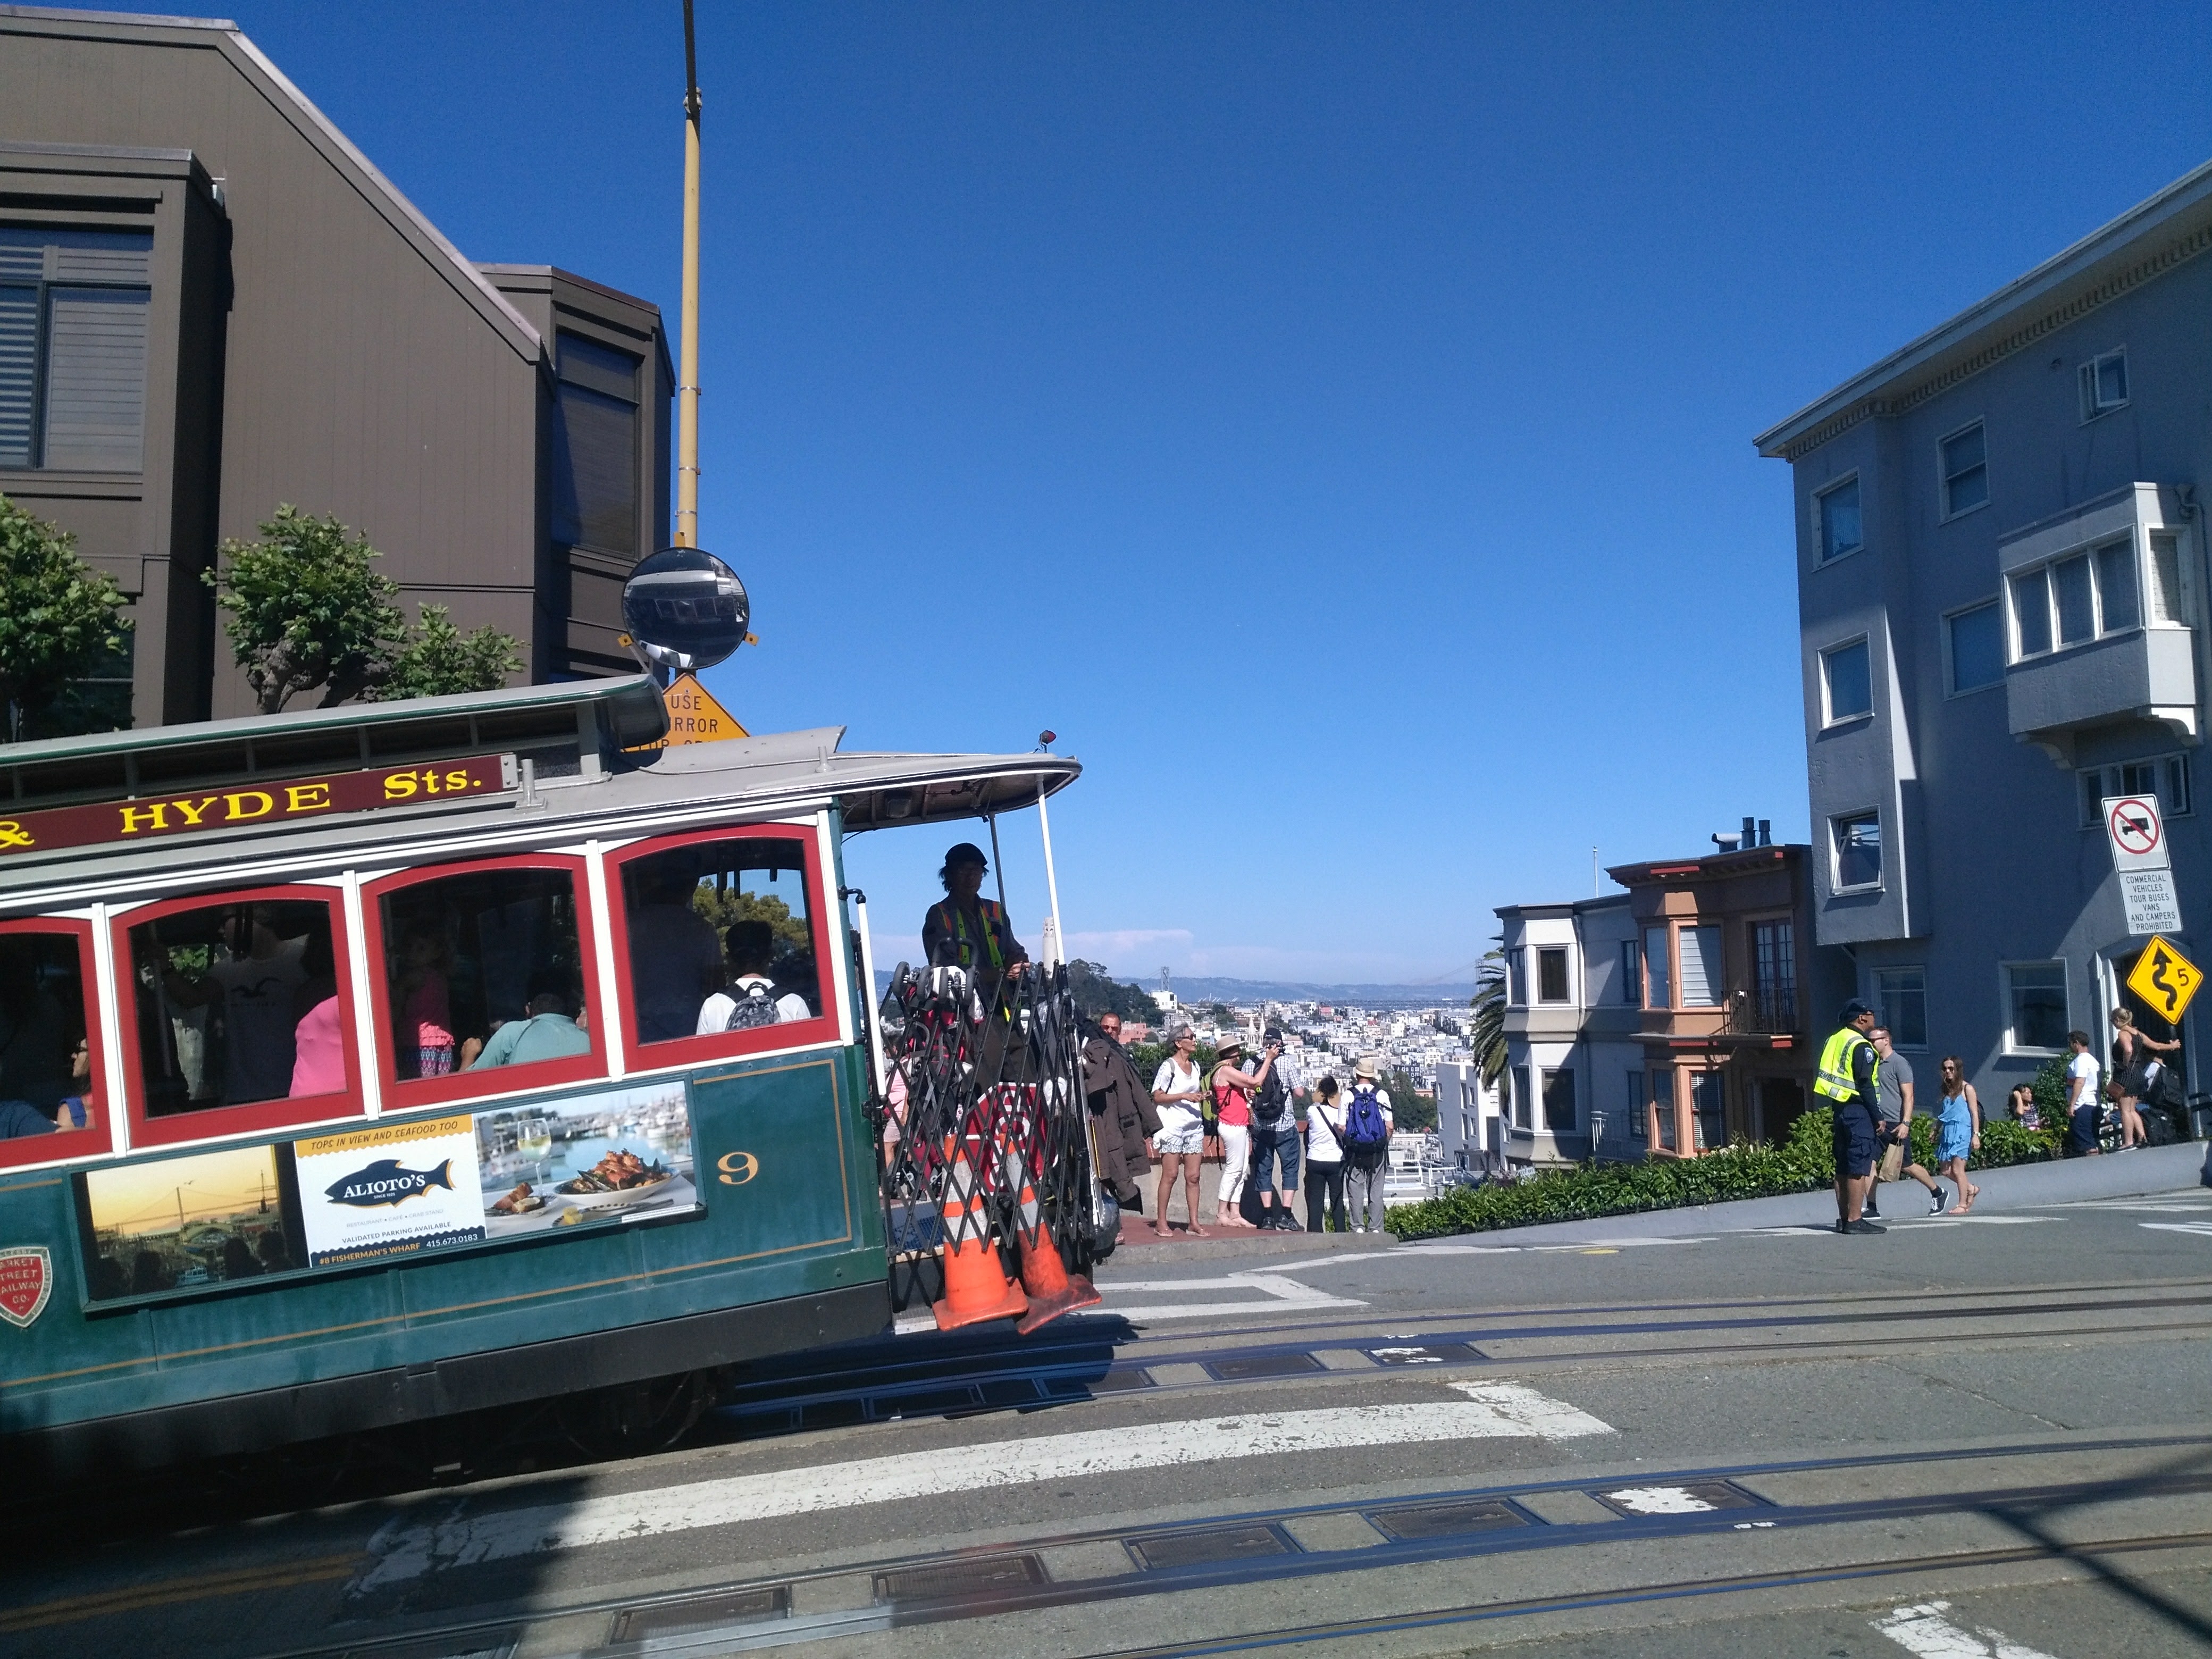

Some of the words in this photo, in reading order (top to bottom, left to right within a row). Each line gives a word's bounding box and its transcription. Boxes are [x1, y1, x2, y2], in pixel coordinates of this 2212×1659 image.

[671, 694, 701, 710] USE
[669, 717, 718, 733] IRROR
[0, 820, 35, 849] &
[119, 783, 330, 834] HYDE
[384, 769, 482, 800] Sts.
[2126, 875, 2166, 884] COMMERCIAL
[2133, 884, 2163, 892] VEHICLES
[2130, 894, 2147, 903] TOUR
[2146, 911, 2175, 920] CAMPERS
[2136, 921, 2173, 931] PROHIBITED
[2177, 968, 2190, 987] 5
[312, 1139, 334, 1150] TOPS
[337, 1137, 346, 1146] IN
[349, 1134, 371, 1144] VIEW
[374, 1131, 391, 1141] AND
[395, 1125, 436, 1137] SEAFOOD
[440, 1121, 458, 1131] TOO
[717, 1152, 758, 1185] 9
[343, 1174, 426, 1199] ALIOTO'S
[347, 1218, 382, 1228] RESTAURANT
[342, 1233, 380, 1243] VALIDATED
[382, 1228, 413, 1237] PARKING
[414, 1222, 451, 1232] AVAILABLE
[331, 1247, 388, 1263] FISHERMAN'S
[389, 1242, 421, 1253] WHARF
[426, 1234, 478, 1248] 415.673.0183
[0, 1258, 35, 1269] ARKET
[0, 1269, 37, 1281] TREET
[0, 1281, 41, 1295] AILWAY
